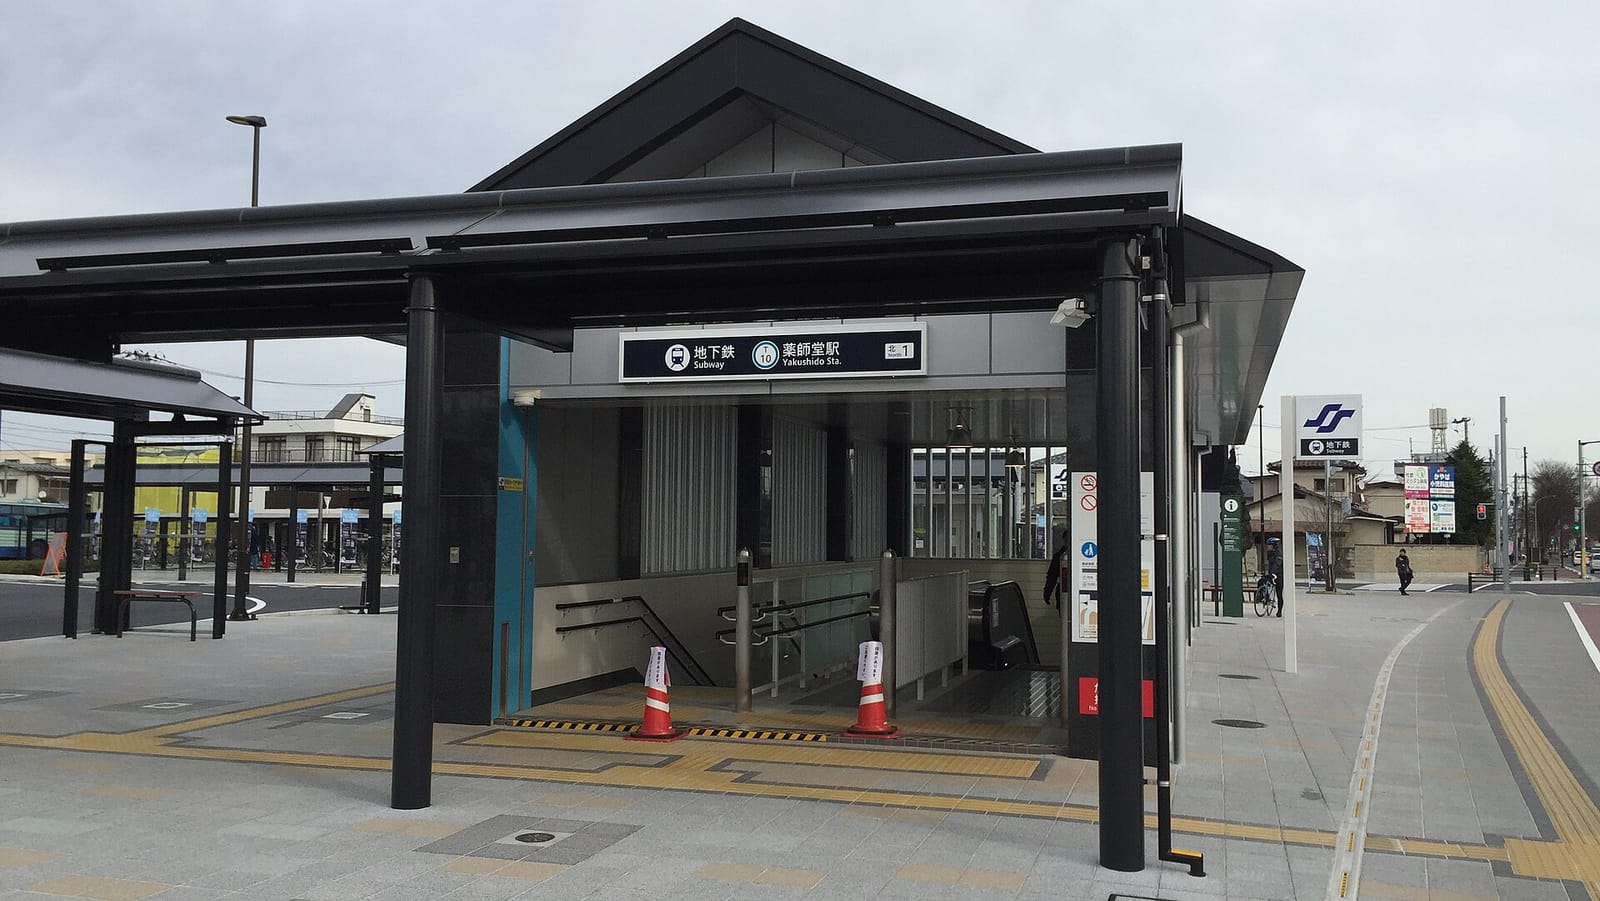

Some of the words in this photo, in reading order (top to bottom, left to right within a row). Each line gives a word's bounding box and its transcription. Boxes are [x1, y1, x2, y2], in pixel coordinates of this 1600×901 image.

[694, 345, 735, 359] 地下鉄
[783, 342, 840, 357] 薬師堂駅
[902, 345, 907, 356] 1
[760, 354, 771, 363] 10
[783, 357, 825, 366] Yakushido
[826, 357, 842, 365] Sta.
[694, 361, 725, 370] Subway
[1326, 441, 1351, 449] 地下鉄
